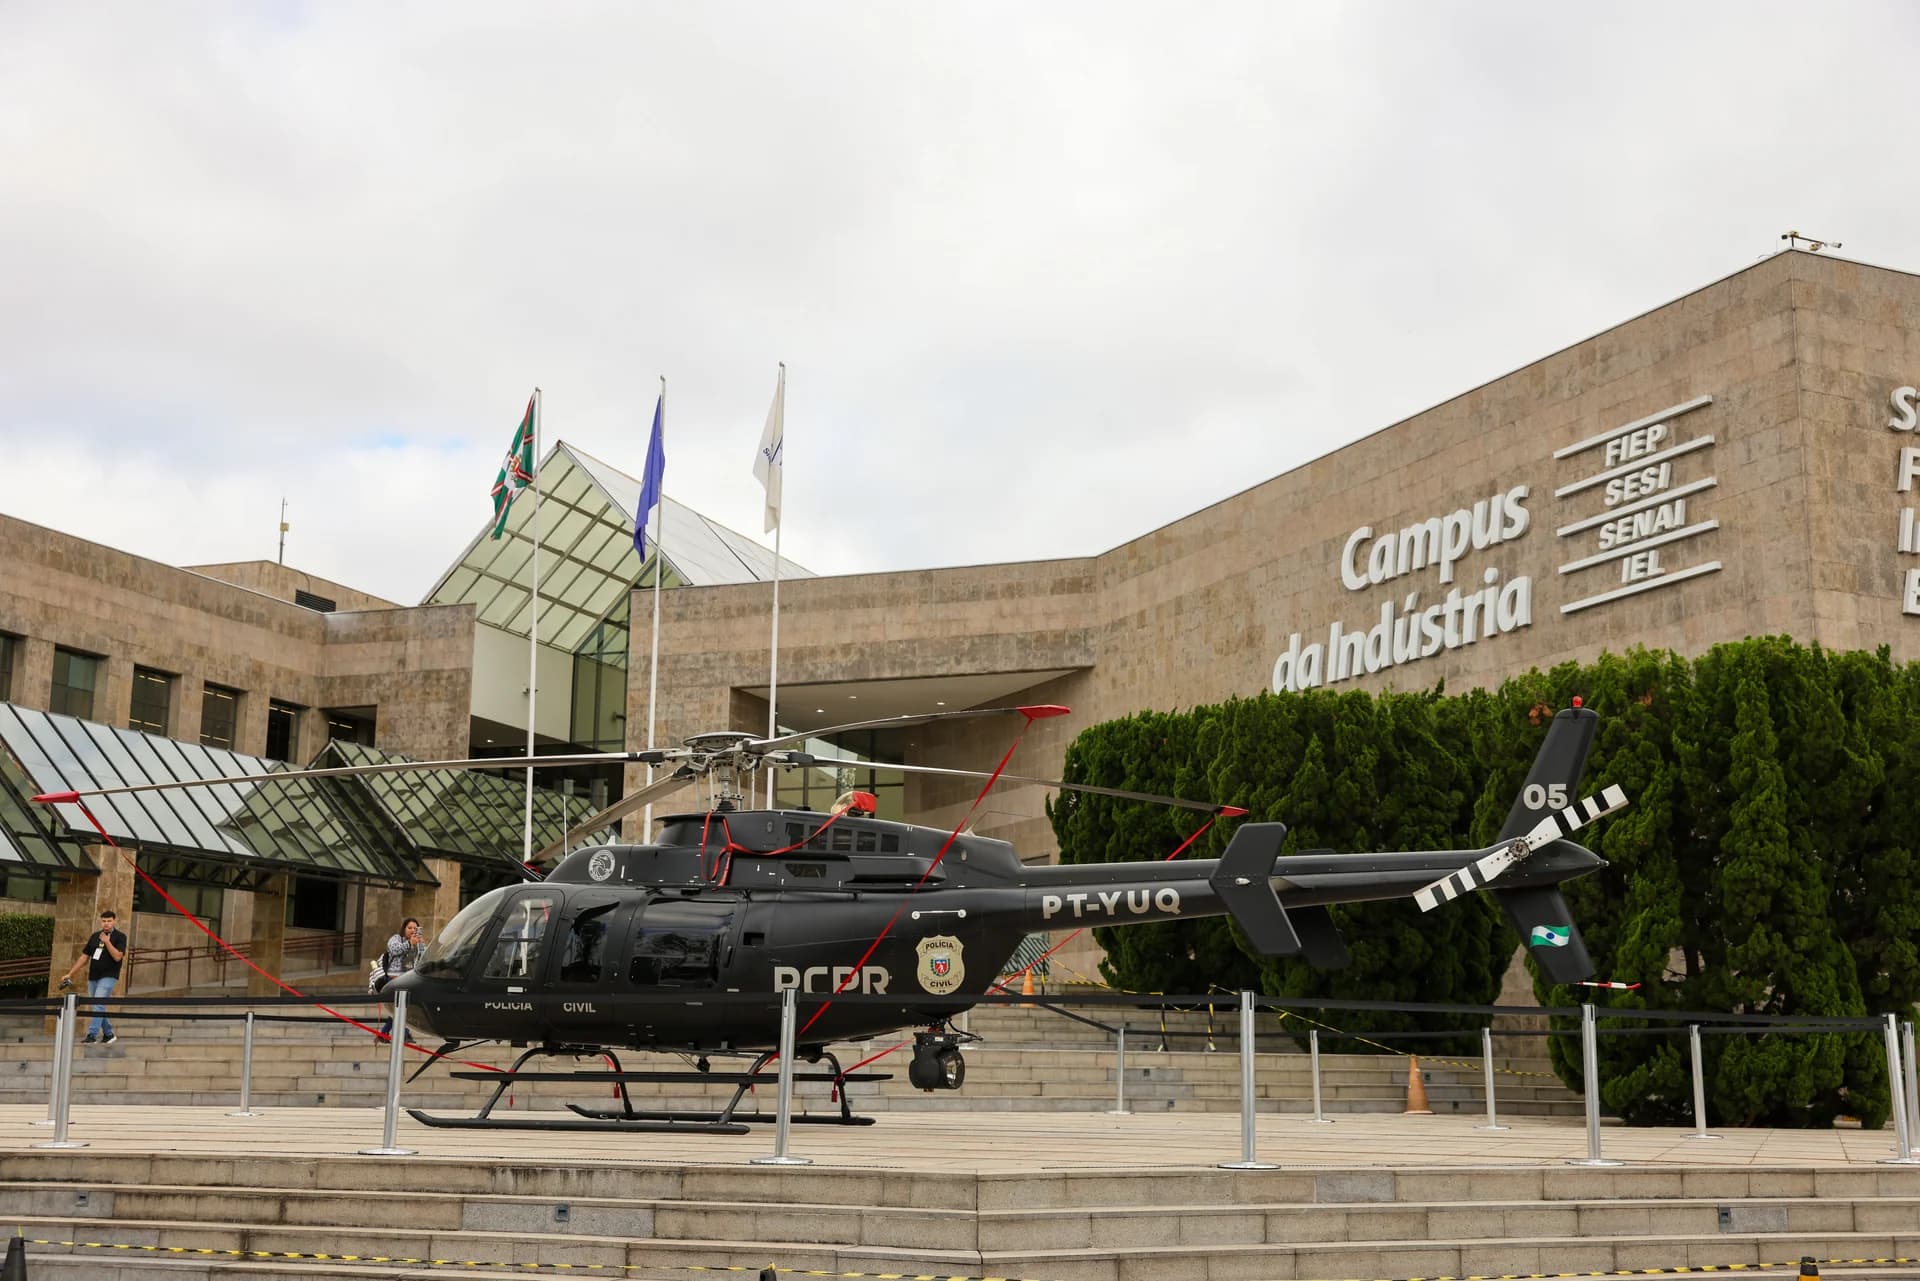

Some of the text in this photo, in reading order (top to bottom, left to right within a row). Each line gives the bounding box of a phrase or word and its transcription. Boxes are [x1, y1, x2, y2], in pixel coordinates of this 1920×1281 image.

[1605, 424, 1668, 467] FIEP
[1604, 462, 1671, 506] SESI
[1341, 485, 1530, 591] Campus
[1599, 499, 1685, 550] SENAI
[1621, 550, 1666, 584] IEL
[1272, 567, 1532, 696] da Indústria
[1523, 783, 1568, 810] 05
[1042, 887, 1181, 919] PT-YUQ
[930, 980, 953, 988] CIVIL
[563, 1002, 597, 1013] CIVIL
